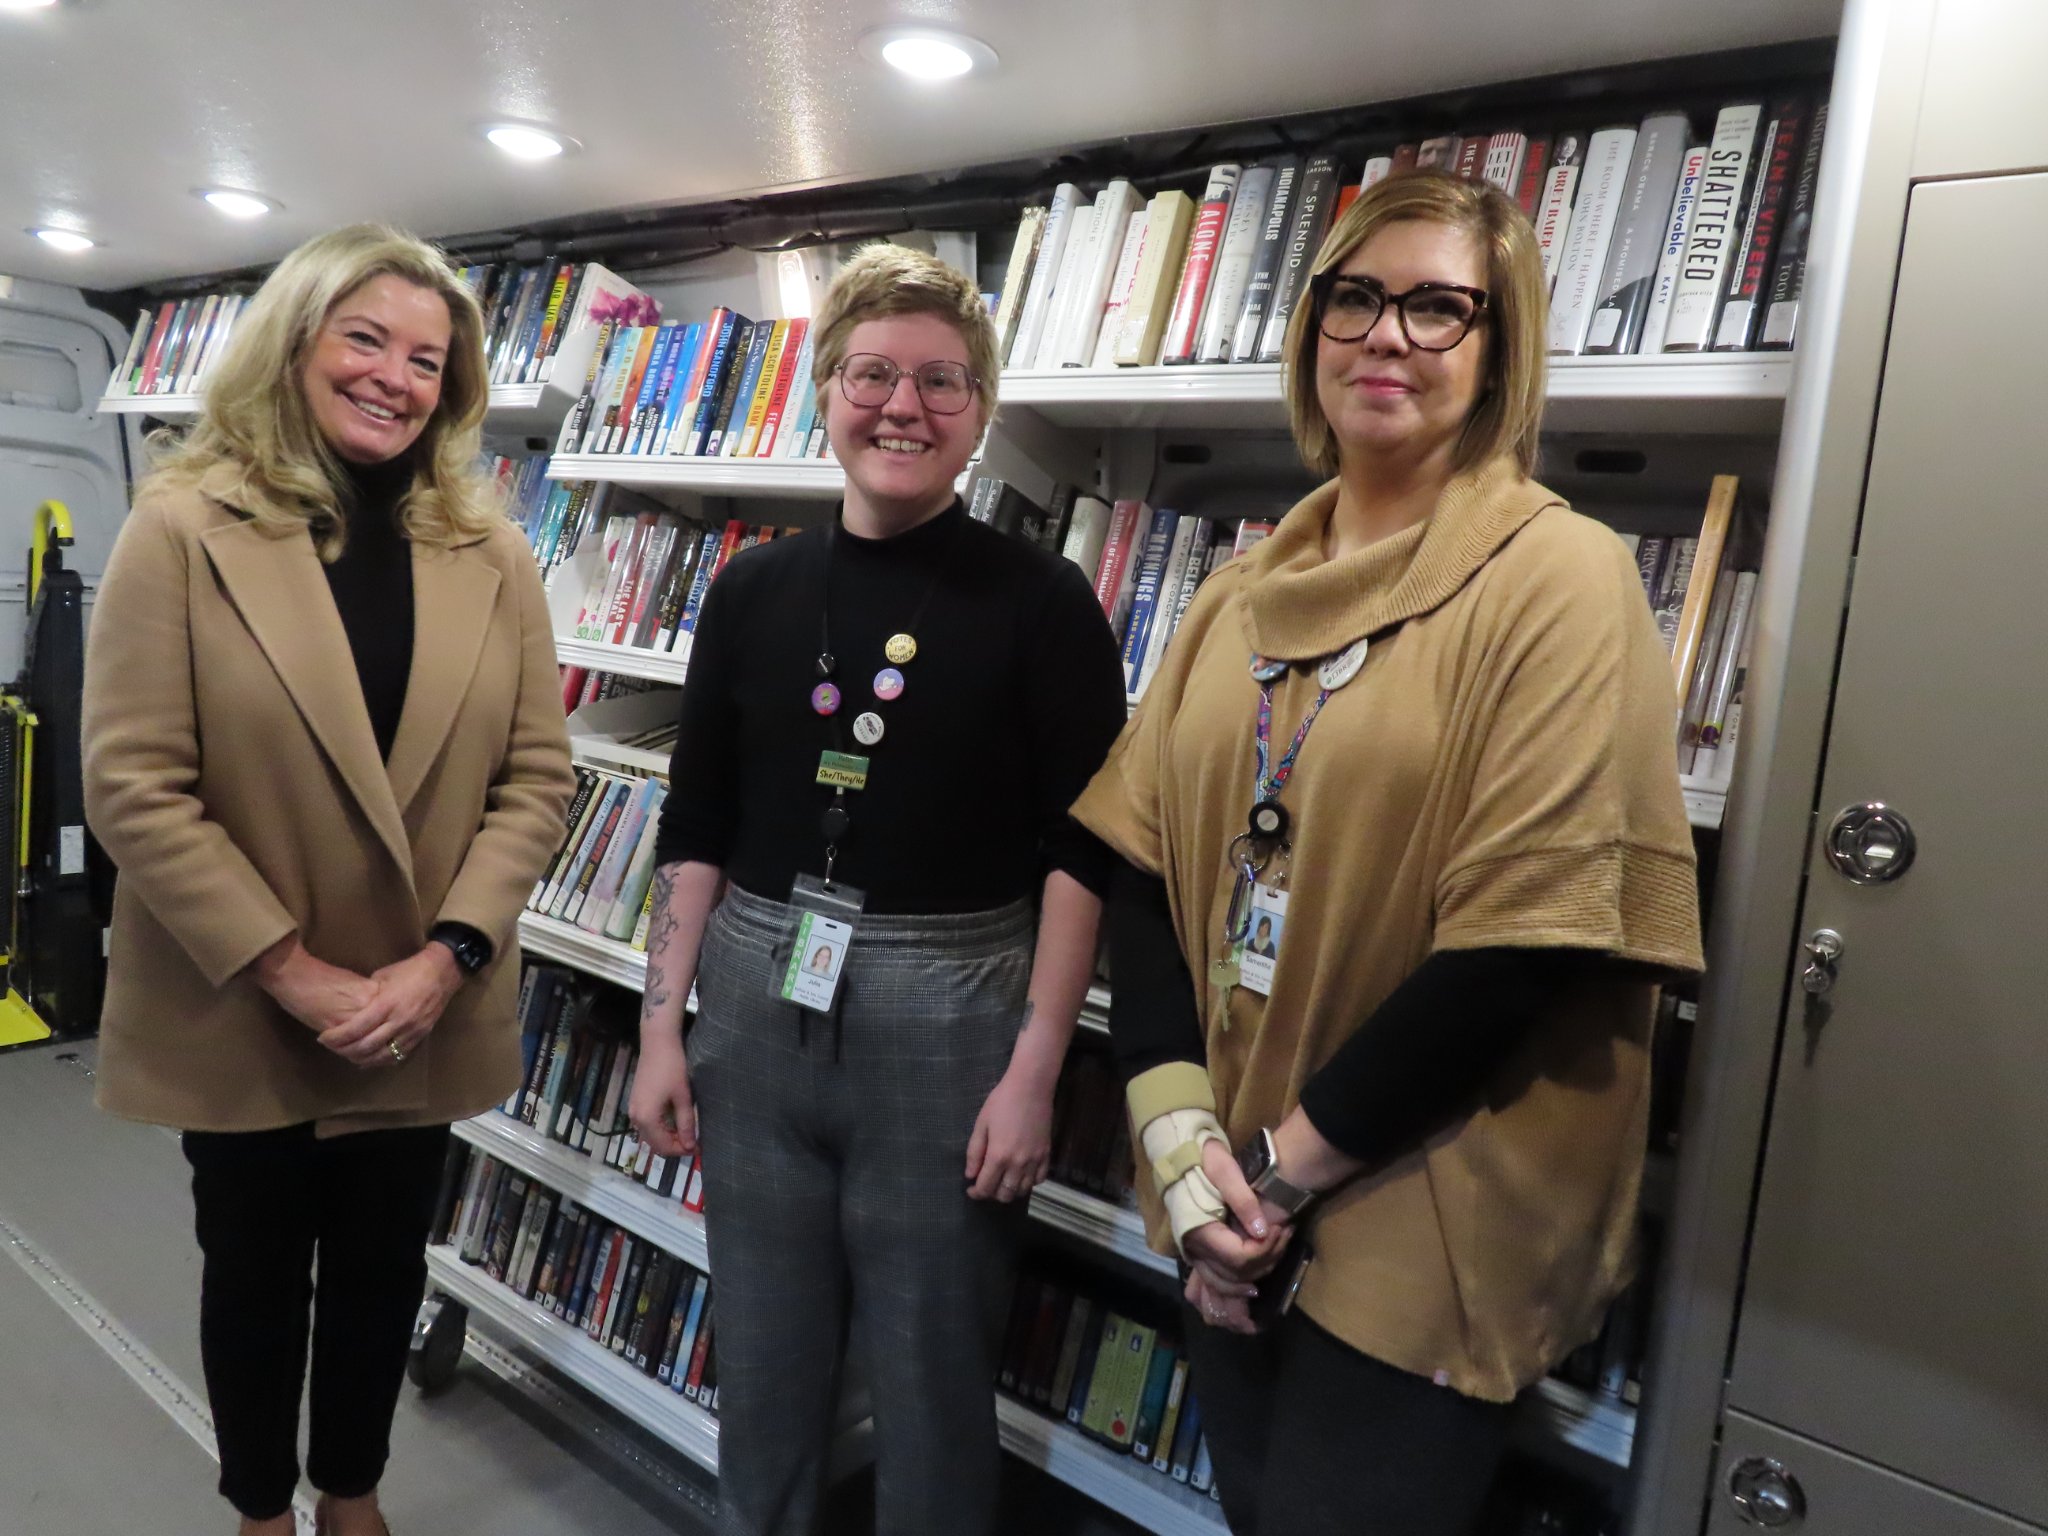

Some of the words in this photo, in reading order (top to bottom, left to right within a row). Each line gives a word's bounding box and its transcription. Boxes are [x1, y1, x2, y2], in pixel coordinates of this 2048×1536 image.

[1463, 143, 1477, 163] THE
[1489, 150, 1511, 165] LET
[1608, 140, 1620, 161] THE
[1770, 119, 1793, 182] TEAM
[1306, 166, 1332, 175] LARSON
[1598, 166, 1613, 199] ROOM
[1265, 167, 1295, 240] INDIANAPOLIS
[1579, 193, 1593, 222] JOHN
[1632, 175, 1647, 212] OBAMA
[1667, 155, 1703, 256] Unbelievable
[1047, 195, 1067, 238] After
[1092, 198, 1106, 234] OPTION
[1540, 208, 1562, 248] BAIER
[1587, 202, 1605, 242] WHERE
[1684, 150, 1742, 281] SHATTERED
[1193, 208, 1220, 263] ALONE
[1290, 195, 1317, 268] SPLENDID
[1568, 225, 1585, 271] BOLTON
[1583, 248, 1593, 259] IT
[1742, 208, 1774, 296] VIPERS
[1255, 271, 1269, 279] LYNN
[1288, 272, 1296, 286] AND
[1612, 238, 1631, 290] PROMISED
[1733, 269, 1741, 288] HOUSE
[1658, 275, 1671, 305] KATY
[718, 323, 732, 348] JOHN
[772, 335, 783, 353] LISA
[790, 334, 801, 352] LISA
[651, 343, 663, 365] NORA
[668, 342, 681, 363] NORA
[640, 366, 655, 405] ROBERTS
[702, 348, 725, 397] SANDFORD
[758, 356, 774, 399] SCOTTOLINE
[773, 354, 792, 406] SCOTTOLINE
[578, 393, 588, 410] TWO
[1112, 516, 1123, 544] HISTORY
[1157, 516, 1165, 531] THE
[1108, 548, 1115, 557] OF
[1182, 536, 1190, 549] MY
[1098, 559, 1113, 594] BASEBALL
[1136, 533, 1167, 602] MANNINGS
[1175, 553, 1185, 579] FIRST
[1673, 545, 1695, 597] BRUCE
[623, 580, 635, 596] THE
[1179, 556, 1199, 608] BELIEVE
[608, 587, 623, 617] TRIAL
[613, 600, 629, 627] LAST
[1164, 583, 1177, 617] COACH
[1131, 609, 1142, 632] LARS
[888, 636, 913, 646] VOTES
[888, 650, 914, 661] WOMEN
[574, 790, 589, 819] MASTER
[785, 915, 811, 993] LIBRARY
